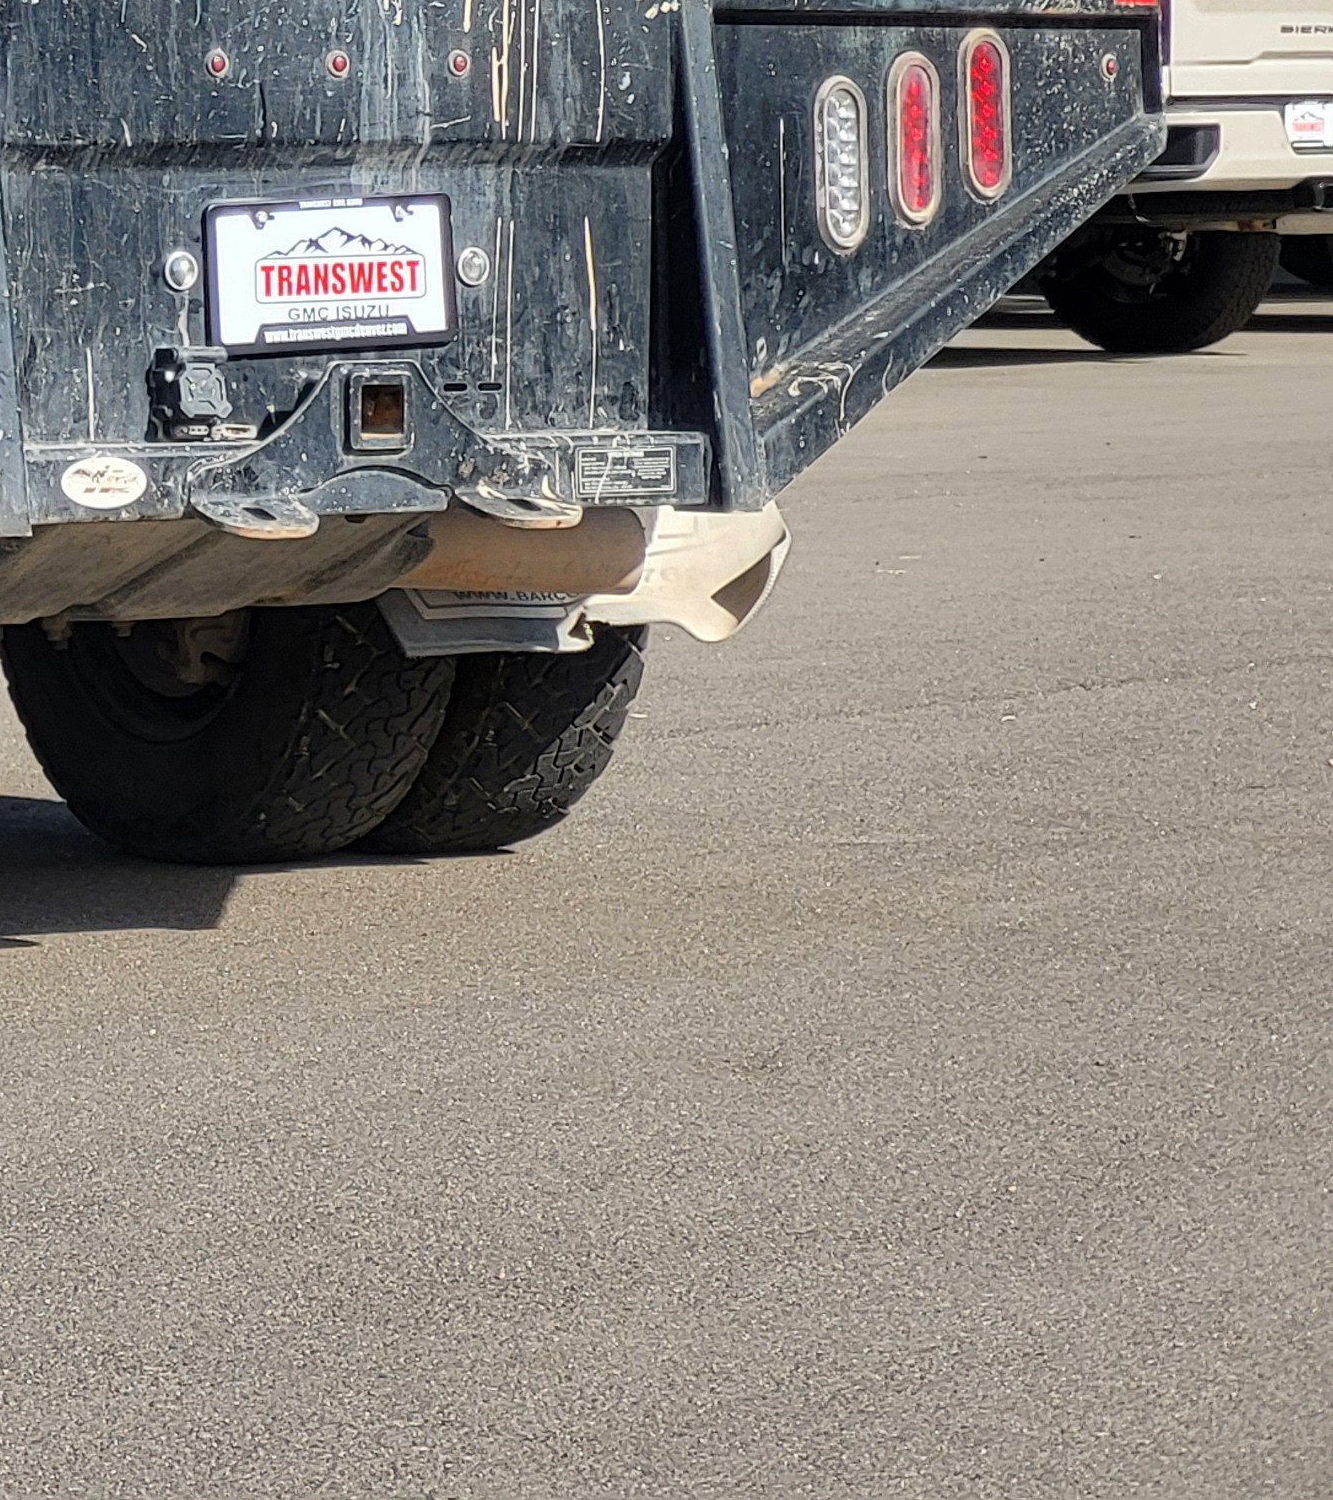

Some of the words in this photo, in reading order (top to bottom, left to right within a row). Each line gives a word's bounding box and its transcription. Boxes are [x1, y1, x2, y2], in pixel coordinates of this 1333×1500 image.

[261, 261, 420, 296] TRANSWEST
[288, 307, 330, 322] GMC
[336, 304, 390, 321] ISUZU
